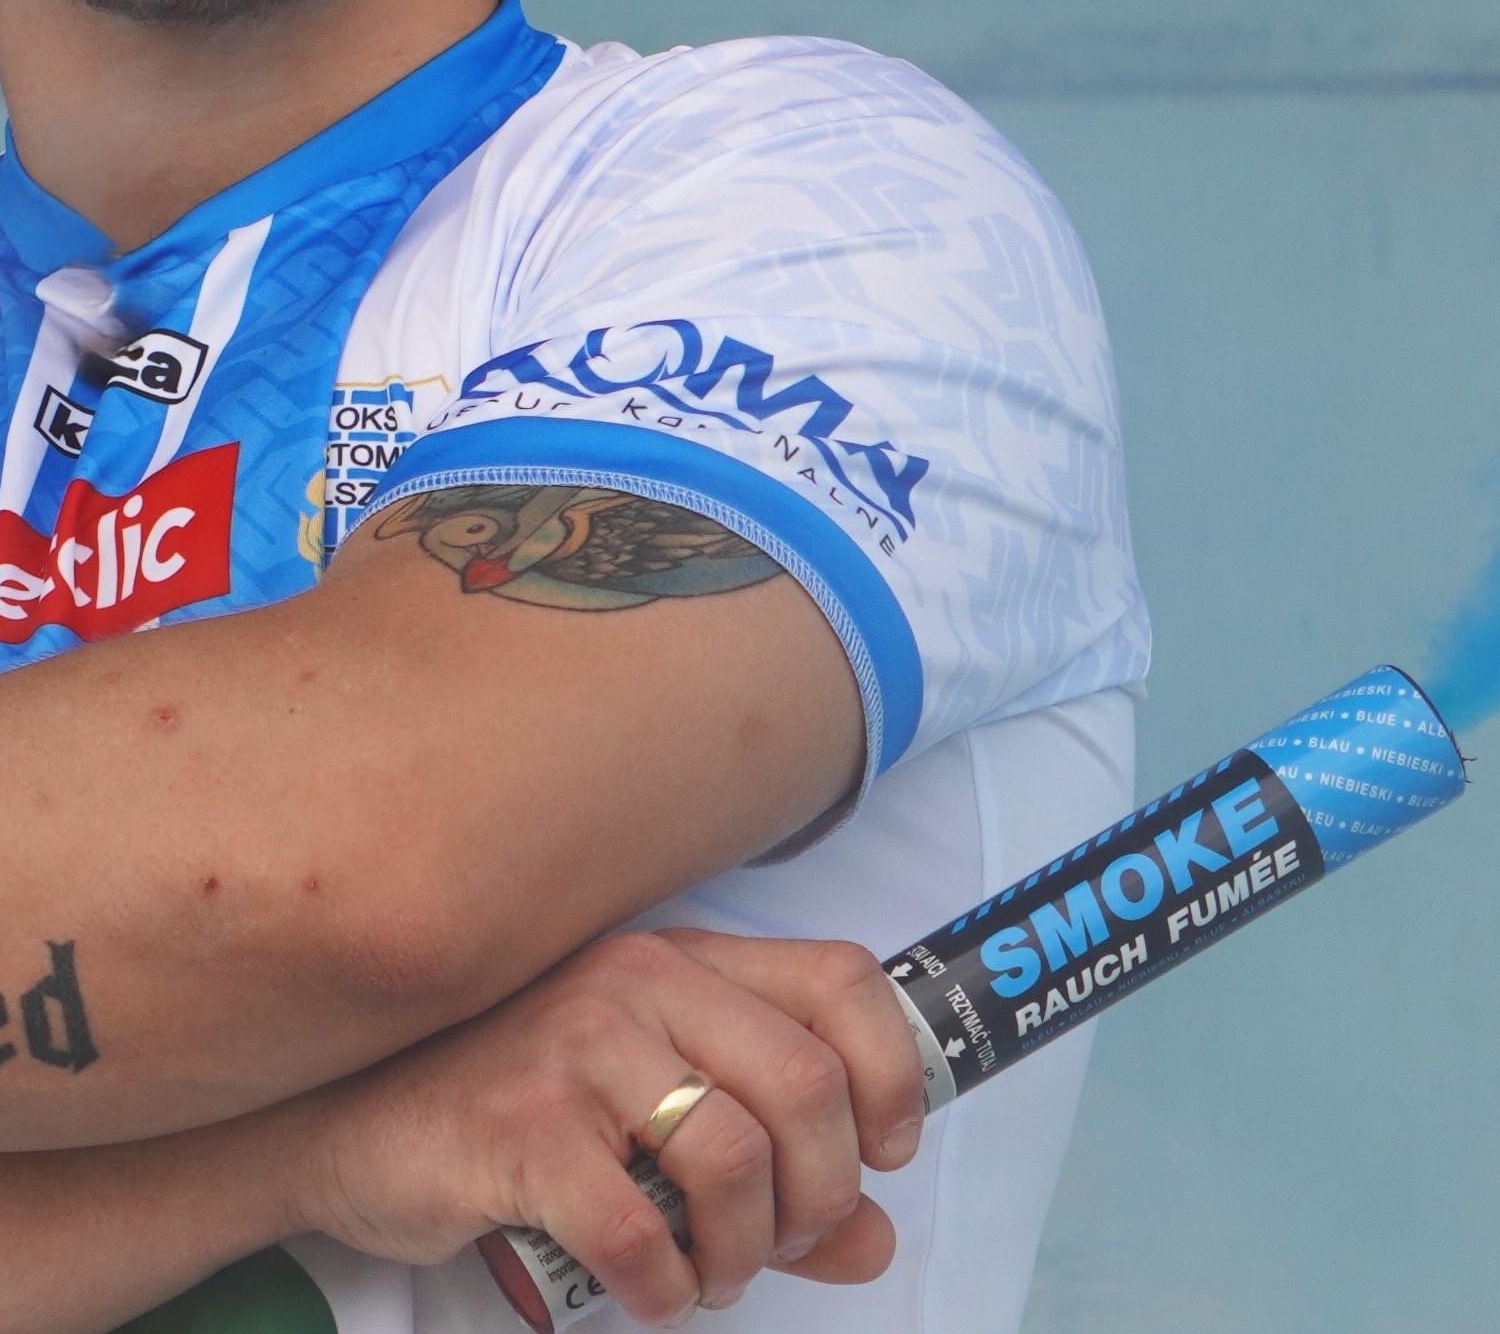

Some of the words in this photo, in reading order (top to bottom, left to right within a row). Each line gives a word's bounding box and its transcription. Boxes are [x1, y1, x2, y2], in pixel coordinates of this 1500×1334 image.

[336, 407, 398, 431] OKS
[1356, 710, 1397, 727] BLUE
[1308, 737, 1350, 754] BLAU
[1371, 746, 1444, 776] NIEBIESKI
[1319, 772, 1393, 803] NIEBIESKI
[980, 777, 1278, 999] SMOKE
[1015, 933, 1148, 1037] RAUCH
[1167, 839, 1300, 944] FUMÉE
[945, 983, 992, 1044] TRZYMAĆ
